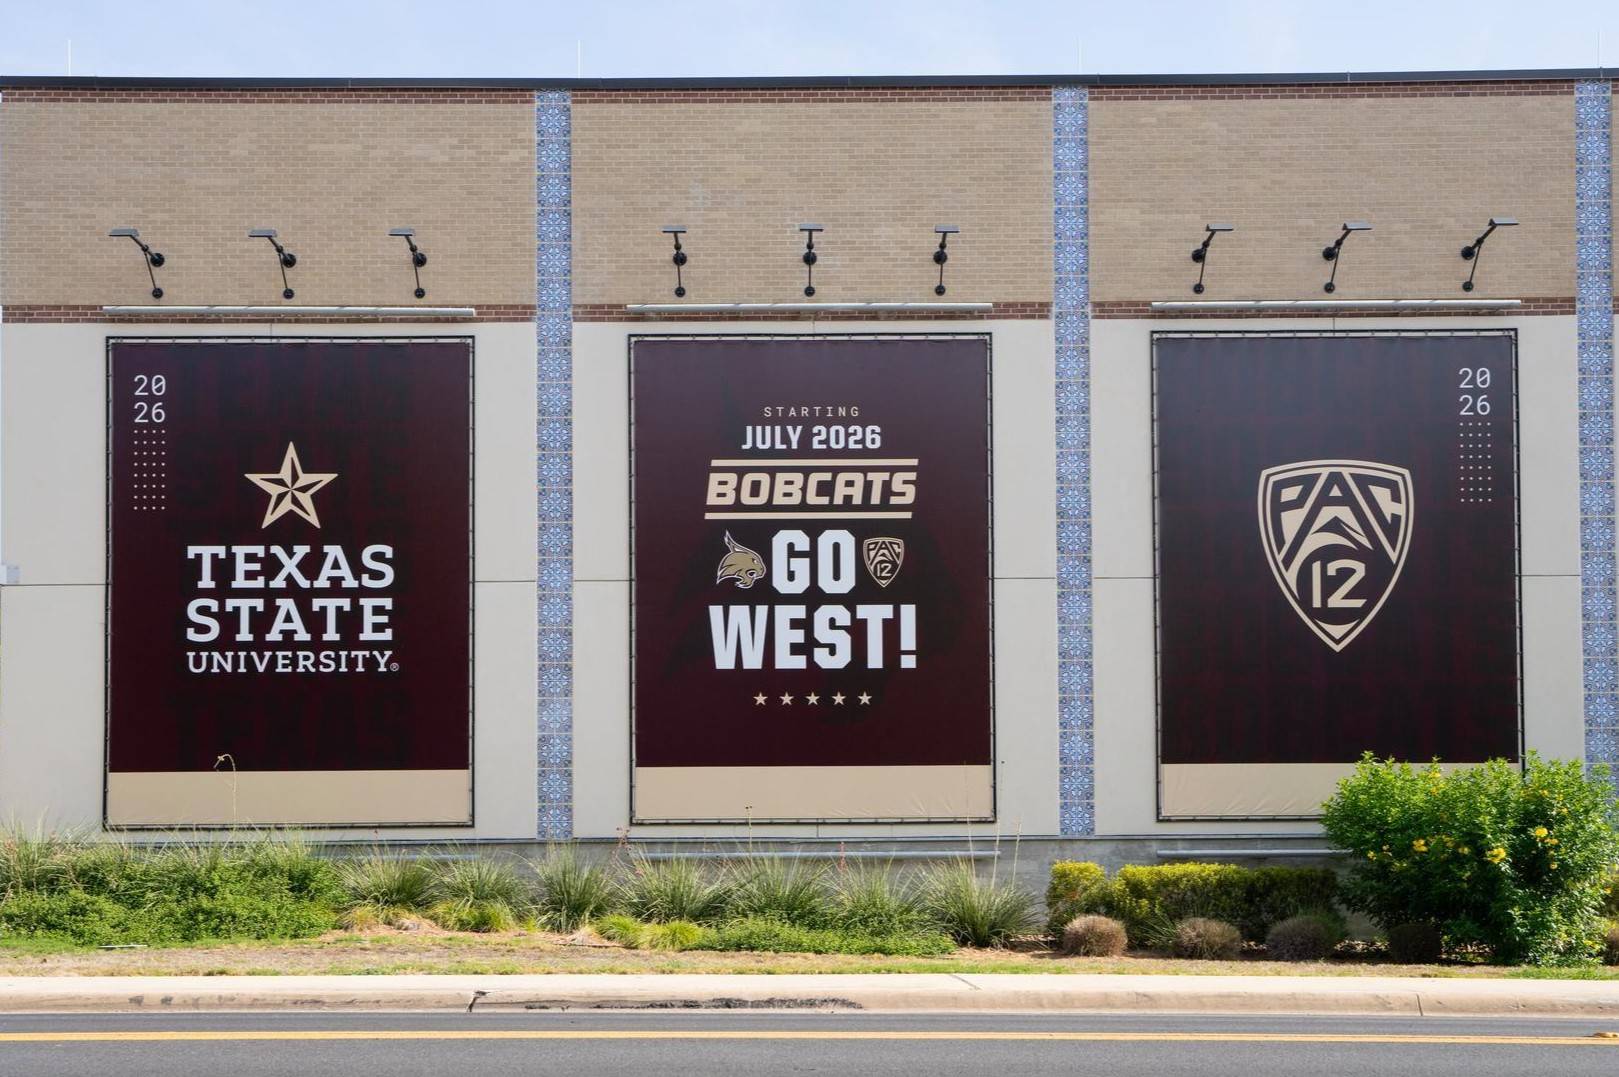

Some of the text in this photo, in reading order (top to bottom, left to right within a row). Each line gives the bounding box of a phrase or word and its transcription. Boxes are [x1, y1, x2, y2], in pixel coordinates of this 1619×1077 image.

[134, 374, 166, 396] 20
[1458, 367, 1491, 389] 20
[133, 401, 166, 423] 26
[763, 406, 860, 418] STARTING
[1458, 394, 1491, 416] 26
[741, 424, 881, 450] JULY 2026
[705, 472, 917, 505] BOBCATS
[187, 544, 395, 589] TEXAS
[772, 529, 856, 594] GO
[877, 564, 891, 577] 12
[1312, 559, 1368, 609] 12
[186, 597, 393, 643] STATE
[708, 604, 917, 670] WEST!
